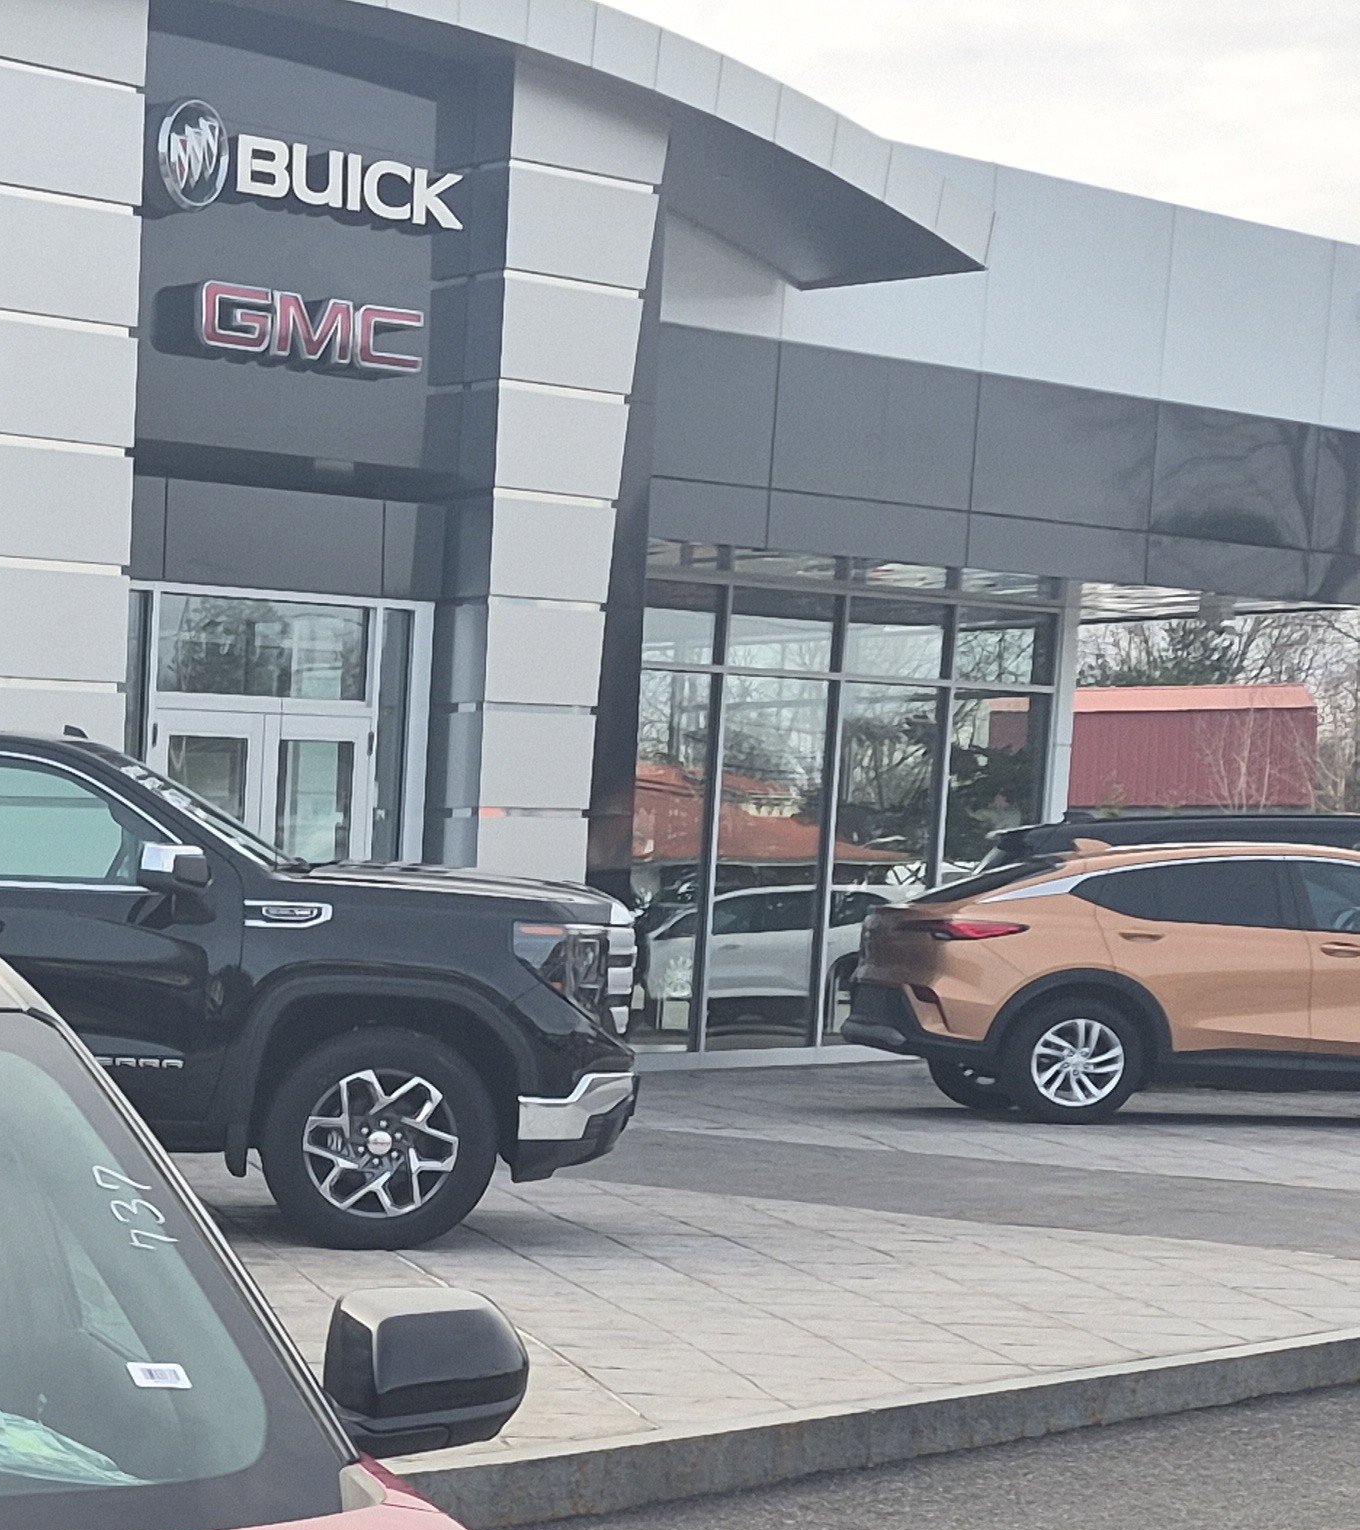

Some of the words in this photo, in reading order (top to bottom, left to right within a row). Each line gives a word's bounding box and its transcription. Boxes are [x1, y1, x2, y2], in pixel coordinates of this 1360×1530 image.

[235, 133, 465, 230] BUICK
[200, 279, 423, 373] GMC
[91, 1164, 179, 1250] 737
